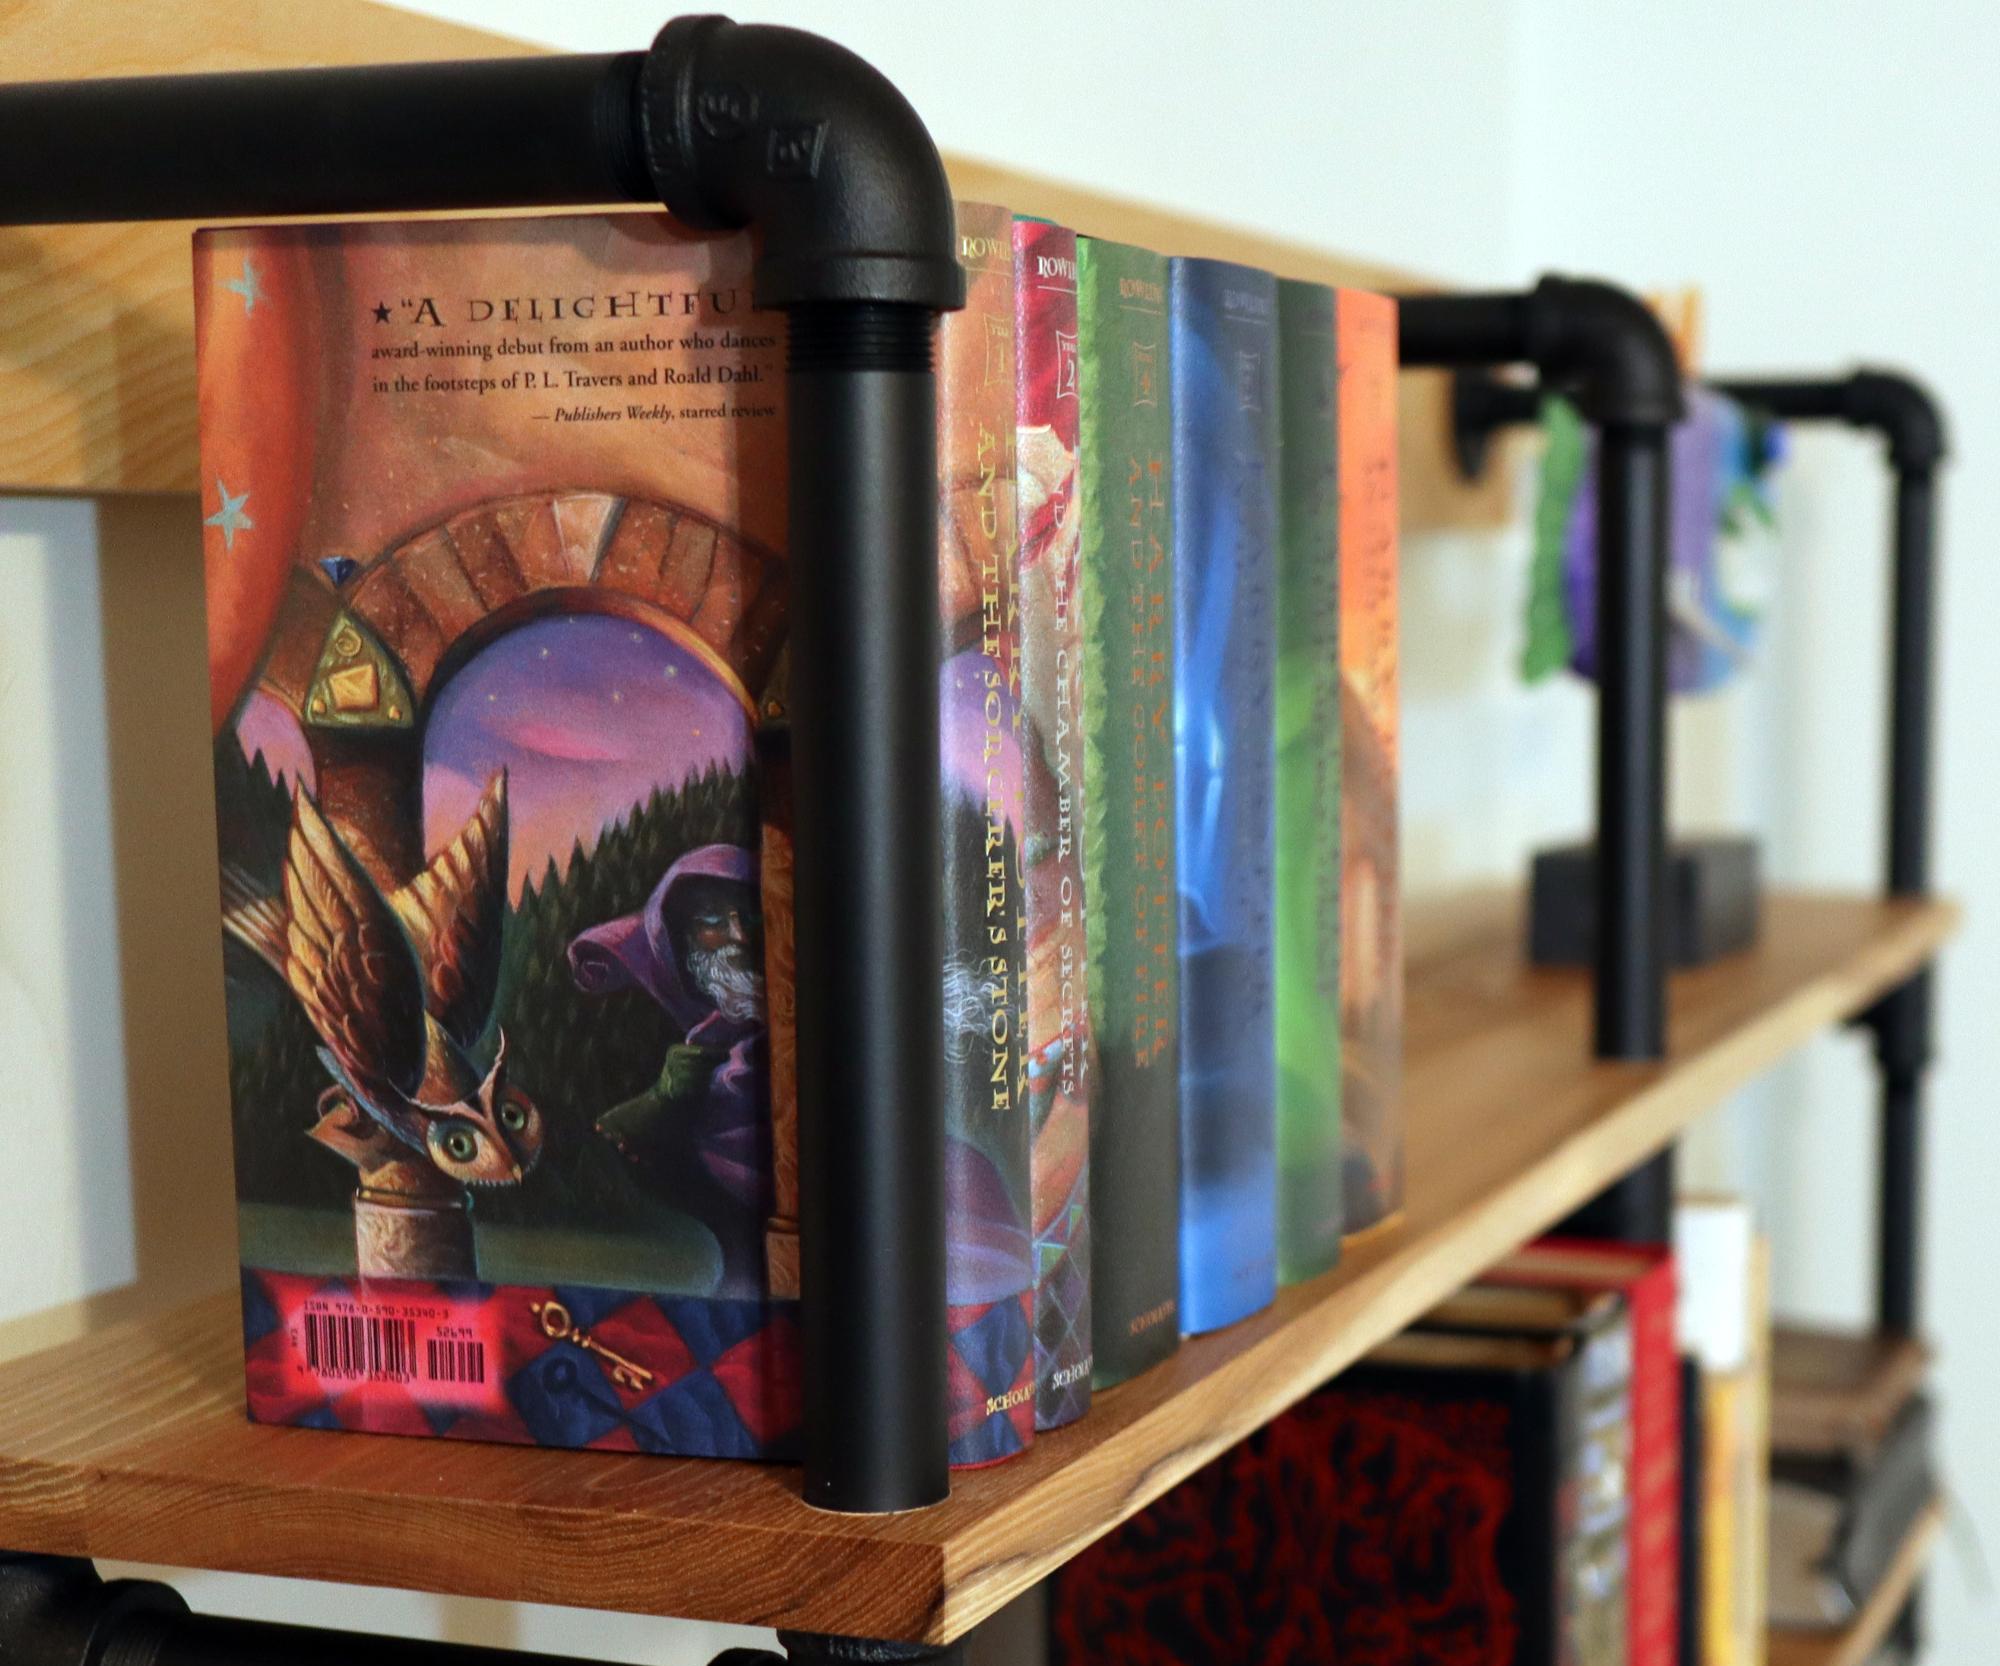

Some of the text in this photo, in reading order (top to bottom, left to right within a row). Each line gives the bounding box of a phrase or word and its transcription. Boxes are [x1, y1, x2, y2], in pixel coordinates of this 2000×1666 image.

[371, 330, 776, 361] award-winning debut from an author who dances
[373, 375, 389, 392] in
[394, 376, 419, 392] the
[424, 373, 496, 395] footsteps
[501, 371, 521, 389] of
[525, 371, 537, 389] P.
[544, 371, 559, 388] L.
[563, 369, 623, 388] Travers
[628, 367, 657, 385] and
[664, 366, 711, 384] Roald
[554, 402, 777, 424] Publishers Weekly, starred review
[977, 422, 998, 540] AND
[982, 553, 1002, 657] THE
[1056, 650, 1073, 864] CHAMBER
[1059, 875, 1074, 928] OF
[986, 956, 1011, 1111] STONE
[1060, 944, 1076, 1096] SECRETS
